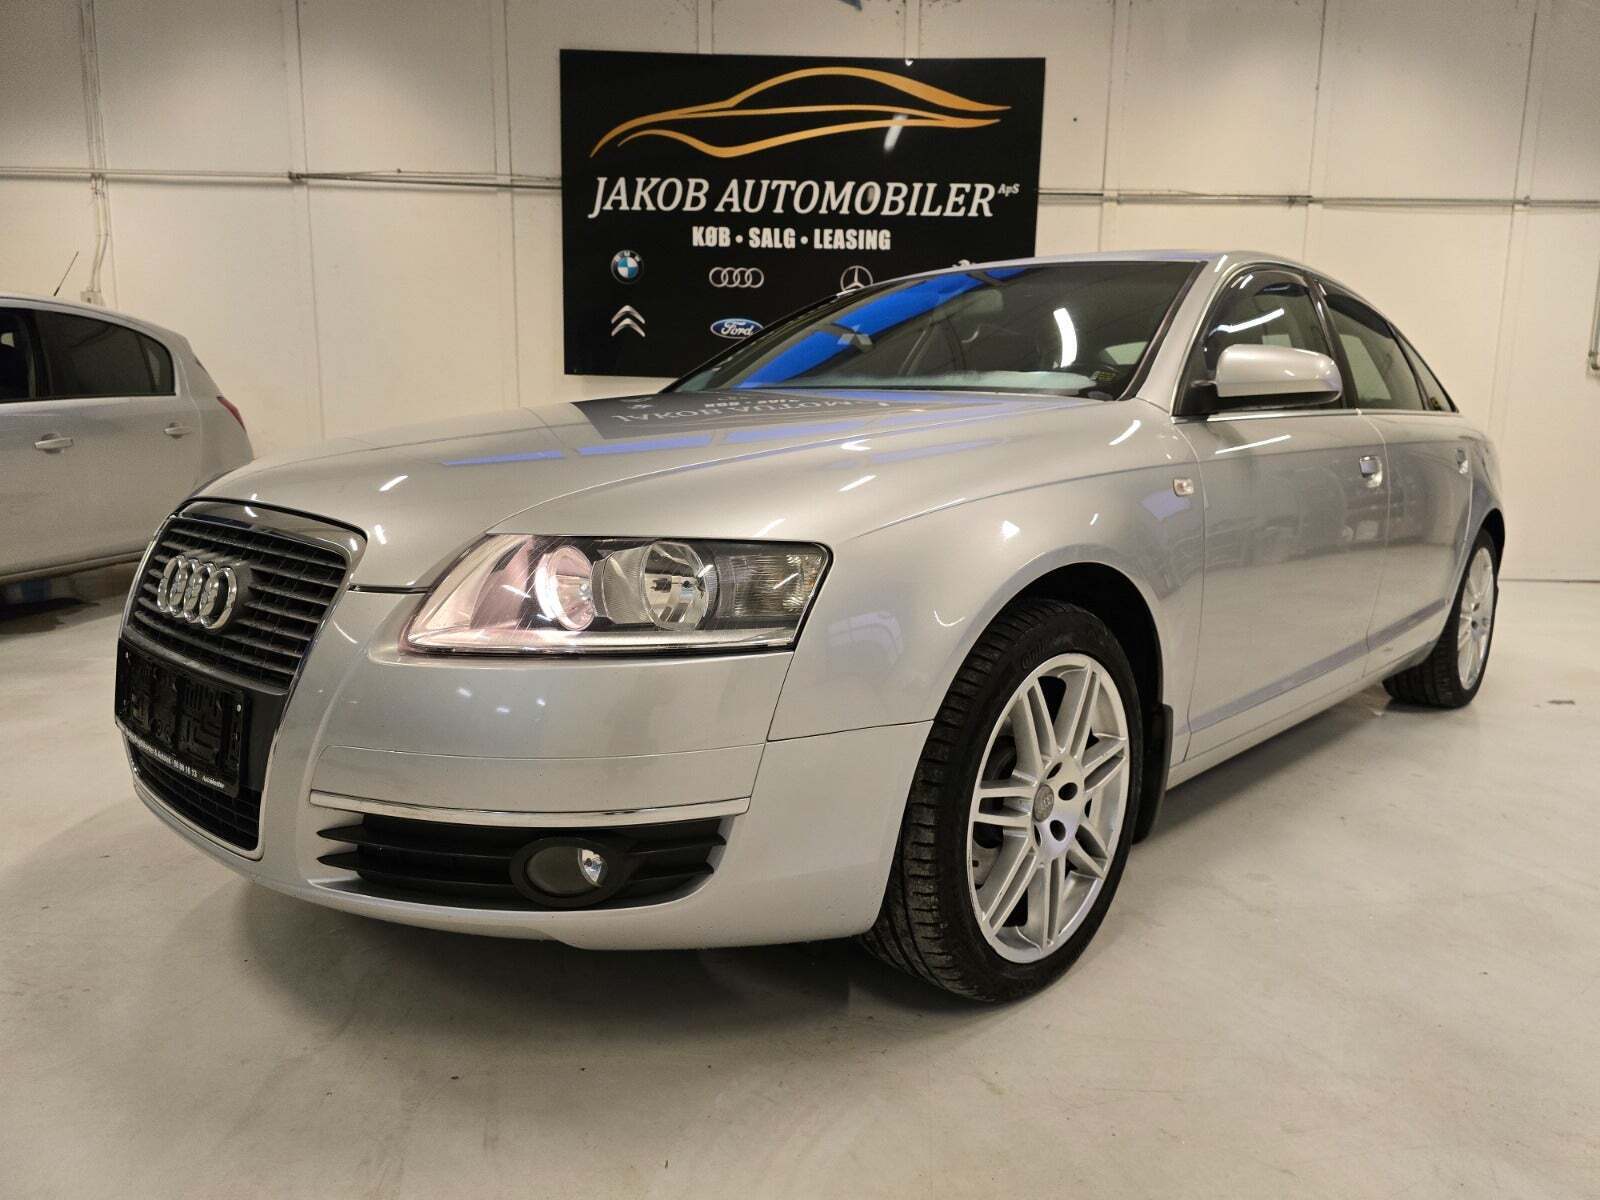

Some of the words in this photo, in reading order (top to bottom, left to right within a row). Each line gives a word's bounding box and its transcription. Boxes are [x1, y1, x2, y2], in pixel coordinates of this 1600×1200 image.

[587, 176, 710, 219] JAKOB
[714, 178, 996, 218] AUTOMOBILER
[997, 183, 1020, 197] ApS
[692, 226, 731, 247] KØB
[748, 227, 796, 249] SALG
[813, 228, 891, 250] LEASING
[721, 320, 755, 336] Ford
